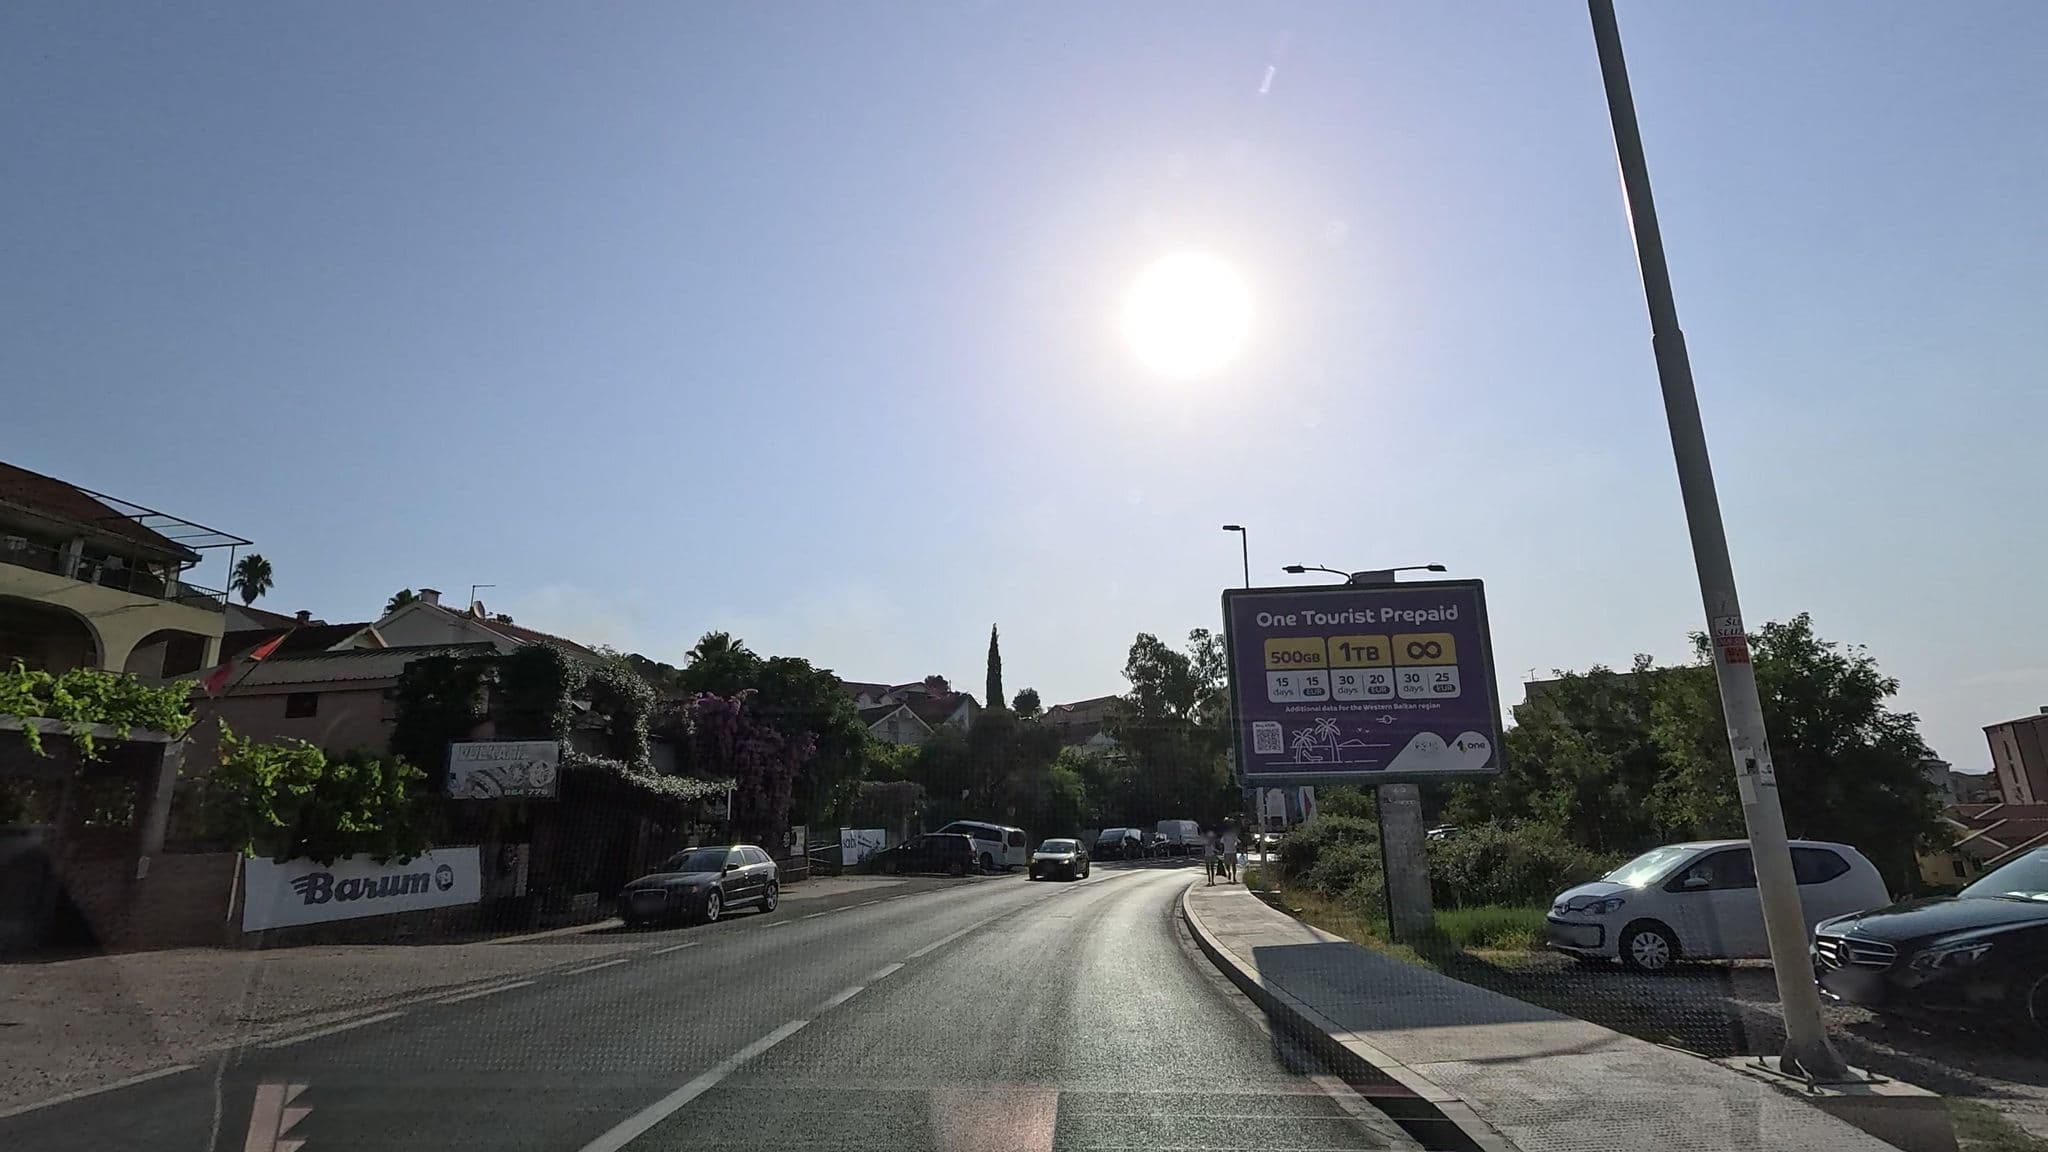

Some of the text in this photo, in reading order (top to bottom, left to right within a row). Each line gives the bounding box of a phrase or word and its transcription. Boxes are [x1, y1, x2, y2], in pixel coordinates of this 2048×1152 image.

[1256, 605, 1460, 627] One Tourist Prepaid
[1271, 650, 1321, 664] 500GB
[1340, 643, 1380, 662] 1TB
[1306, 677, 1319, 686] 15
[1339, 675, 1355, 685] 30
[1370, 674, 1385, 684] 20
[1404, 673, 1420, 683] 30
[1435, 672, 1450, 682] 25
[1276, 678, 1289, 687] 15
[1273, 687, 1294, 697] days
[1337, 686, 1358, 696] days
[1403, 685, 1424, 694] days
[1436, 684, 1453, 692] EUR
[1418, 702, 1441, 710] region
[292, 872, 431, 905] Barum
